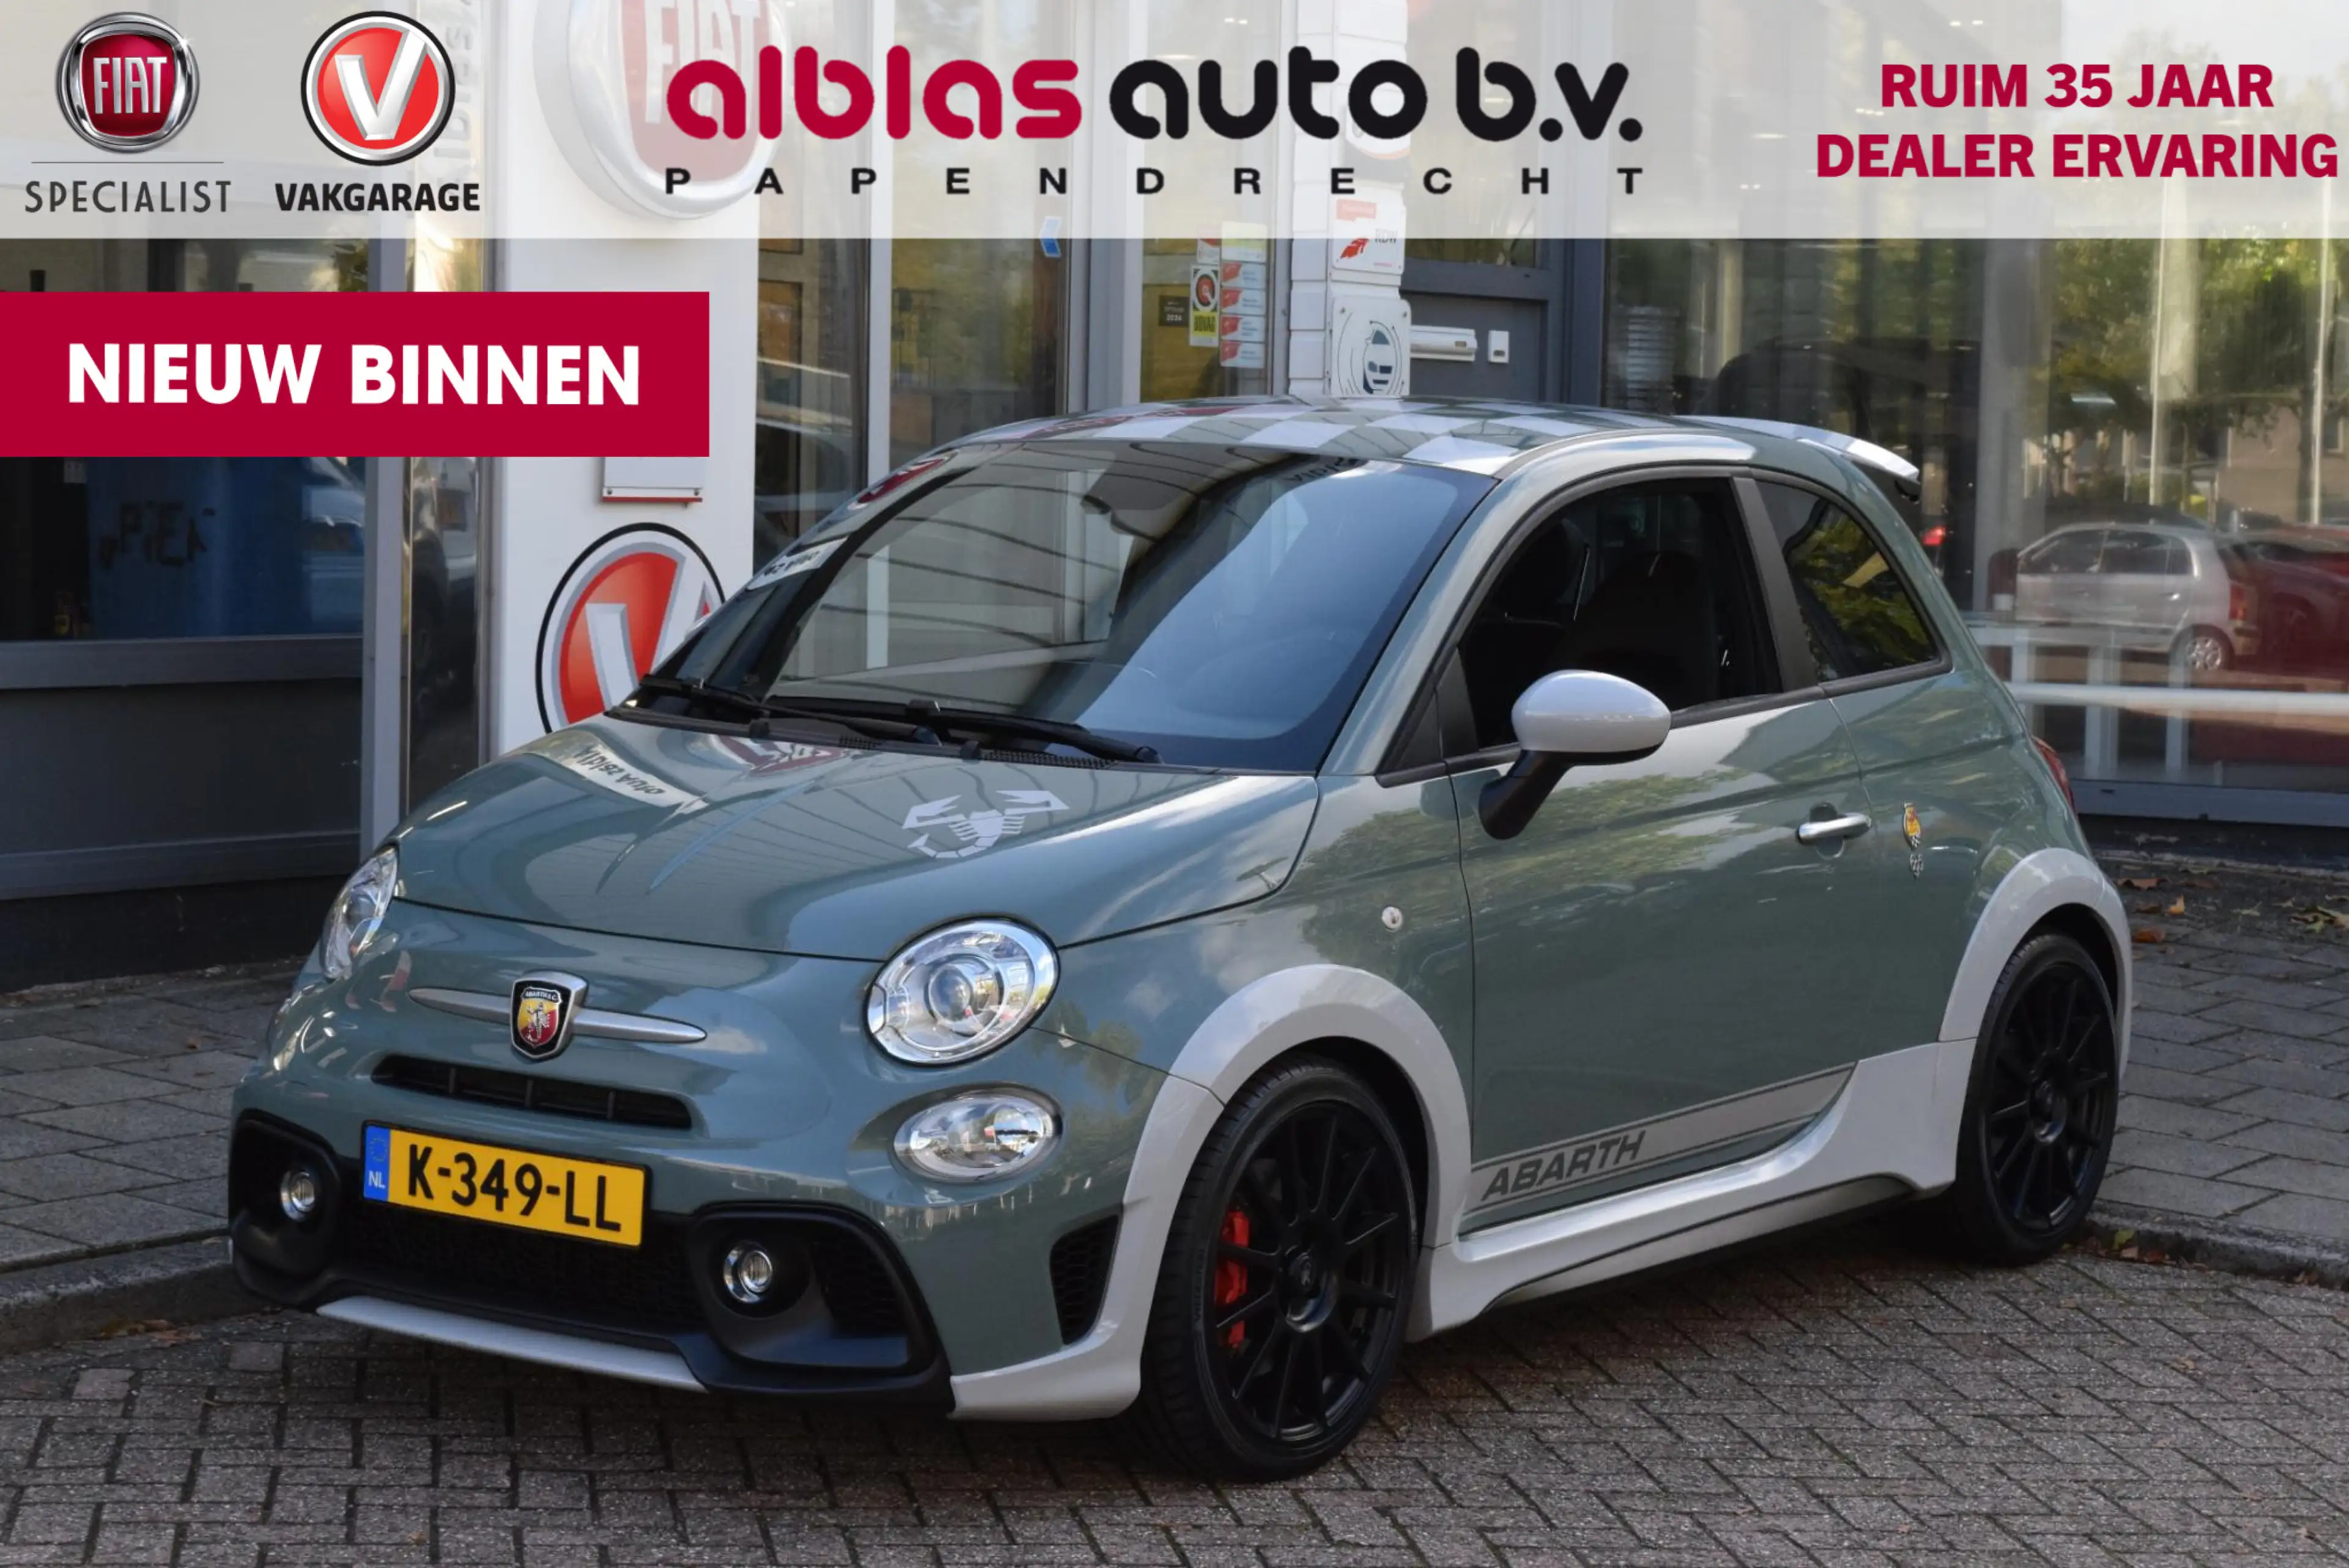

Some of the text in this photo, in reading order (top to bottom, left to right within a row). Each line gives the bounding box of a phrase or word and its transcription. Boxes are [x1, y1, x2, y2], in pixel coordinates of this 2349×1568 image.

[1193, 315, 1215, 333] BOVAG
[368, 1170, 386, 1189] NL
[407, 1143, 622, 1232] K-349-LL
[1480, 1130, 1646, 1202] ABARTH
